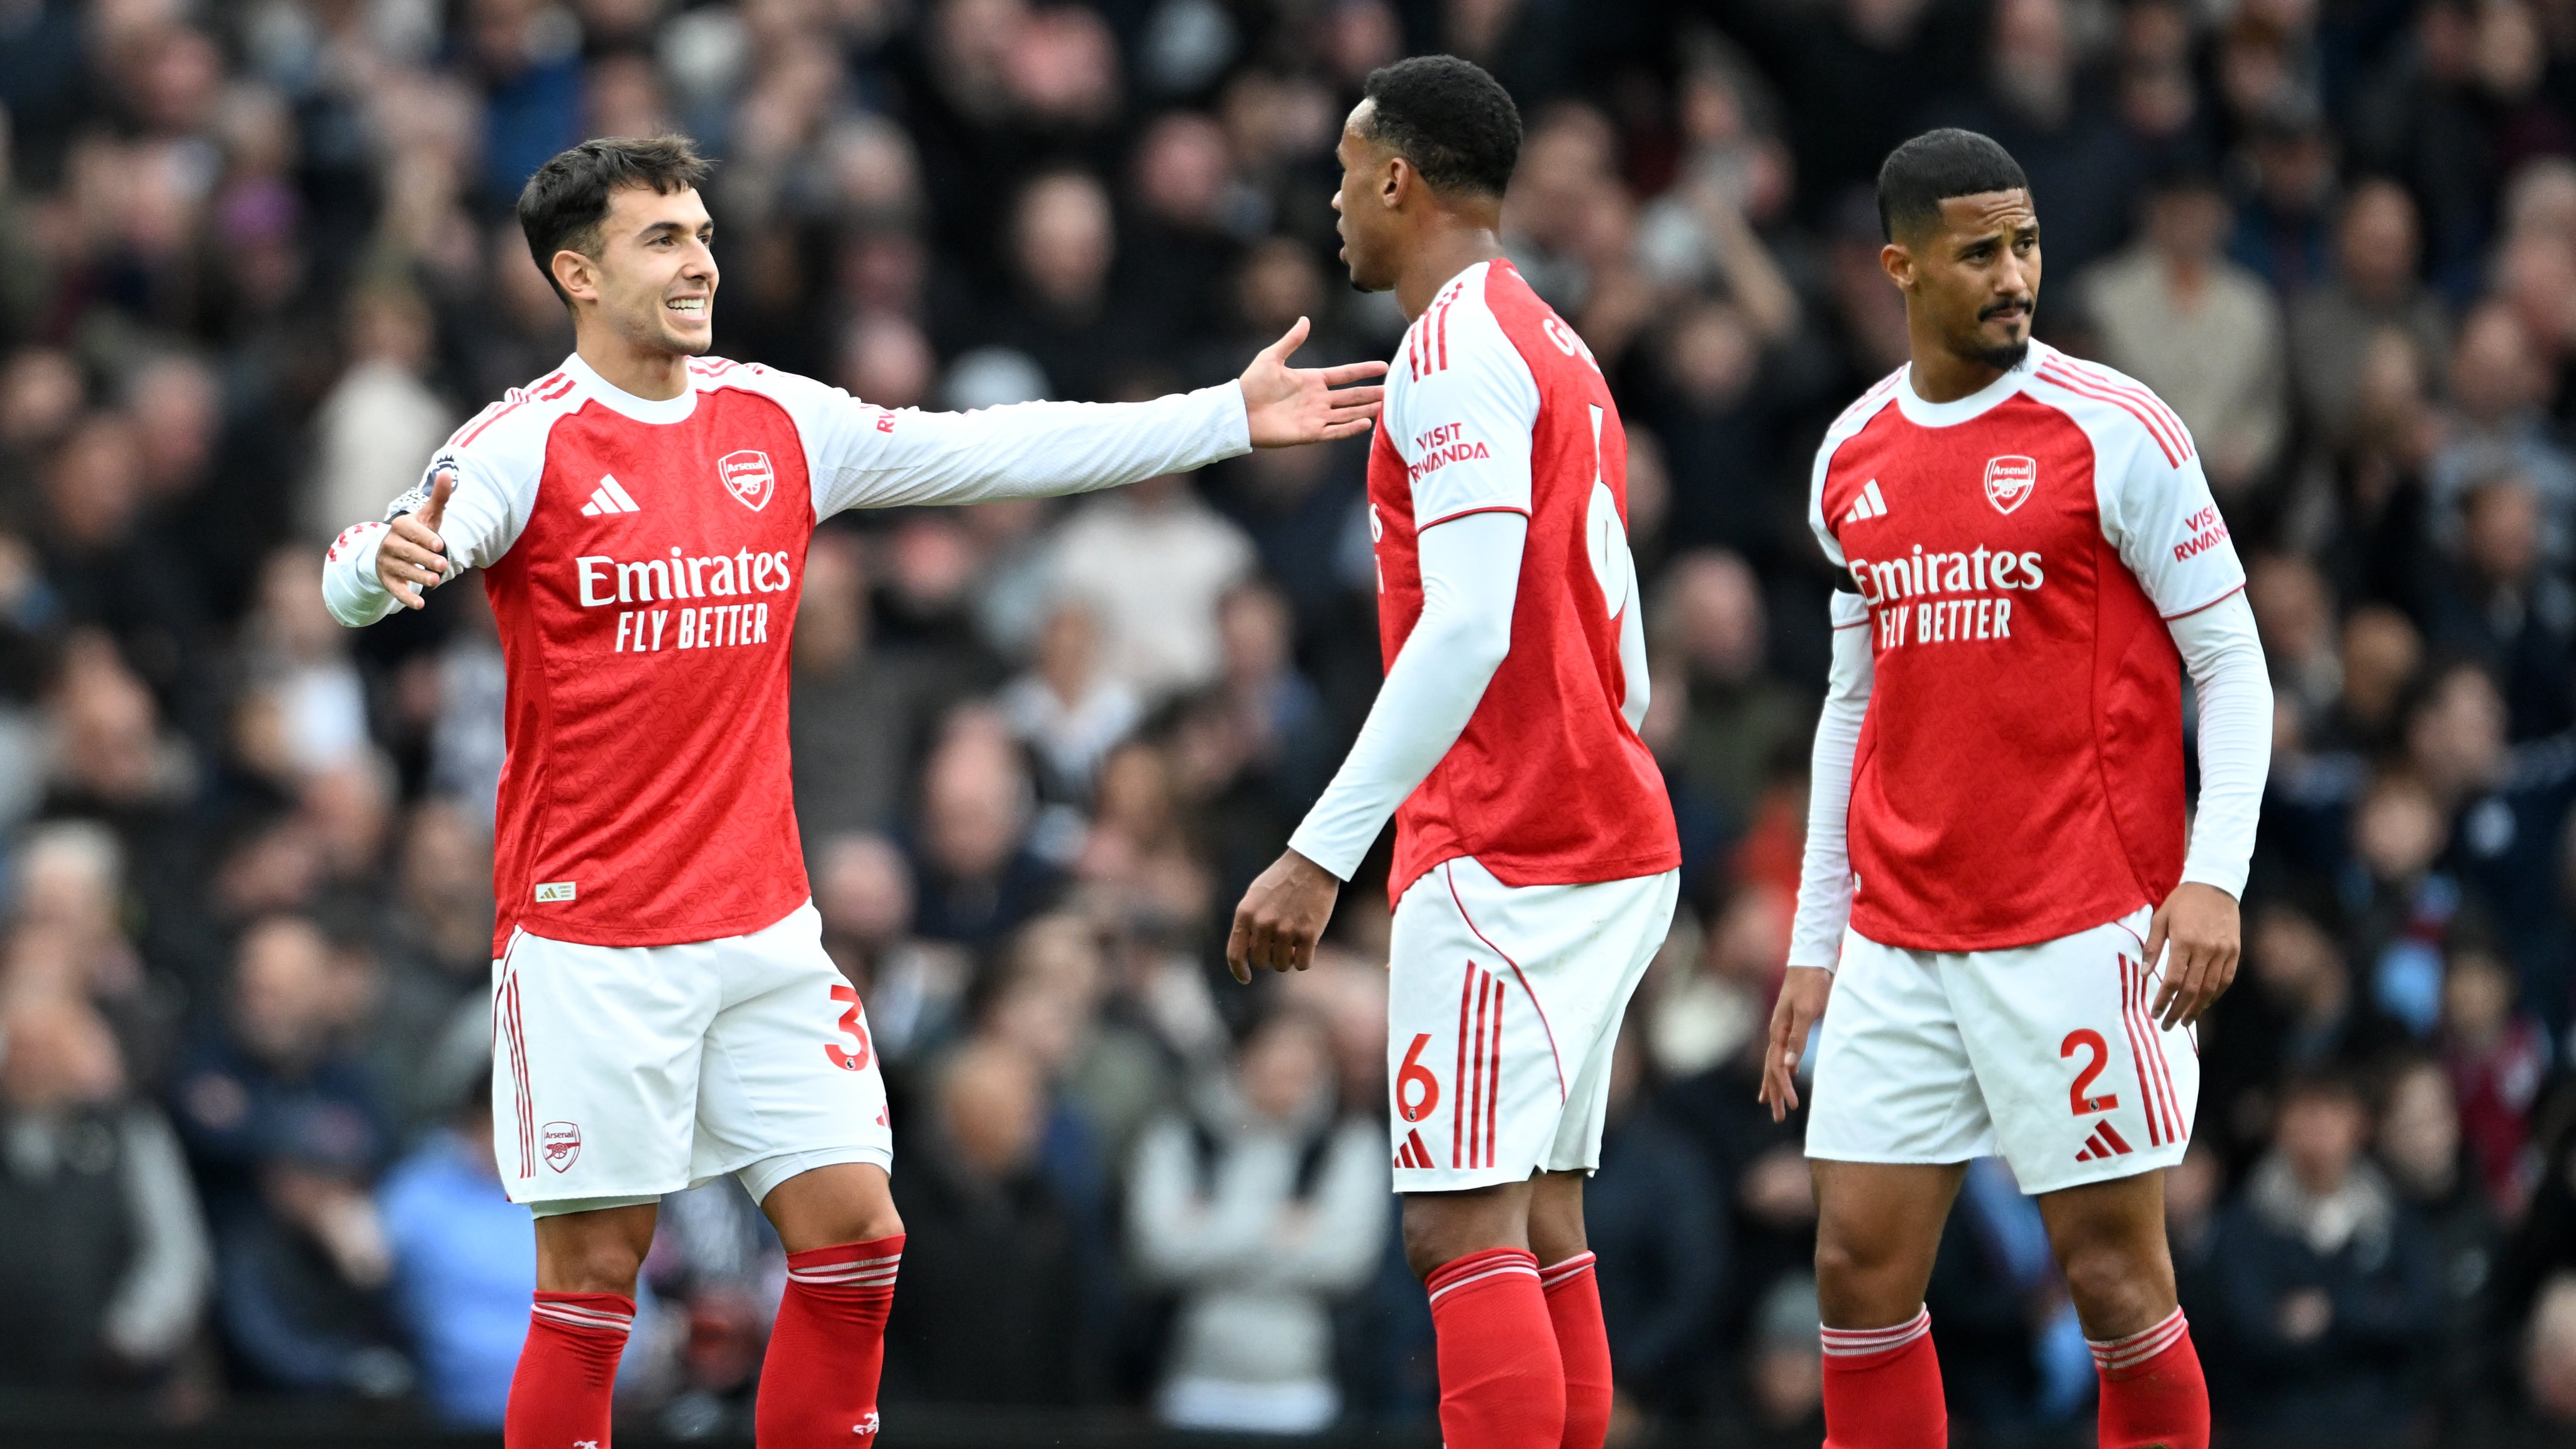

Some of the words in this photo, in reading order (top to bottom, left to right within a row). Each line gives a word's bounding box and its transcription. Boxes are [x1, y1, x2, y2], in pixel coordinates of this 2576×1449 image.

[1416, 422, 1463, 451] VISIT
[727, 460, 765, 473] Arsenal
[1409, 441, 1491, 484] RWANDA
[1993, 465, 2029, 475] Arsenal
[2184, 503, 2217, 532] VISI
[575, 545, 791, 607] Emirates
[1848, 543, 2044, 606] Emirates
[614, 609, 669, 653] FLY
[677, 602, 769, 649] BETTER
[1879, 606, 1910, 649] FLY
[1918, 598, 2011, 643] BETTER
[824, 984, 880, 1072] 3
[1396, 1033, 1440, 1123] 6
[2060, 1028, 2119, 1116] 2
[545, 1130, 574, 1139] Arsenal
